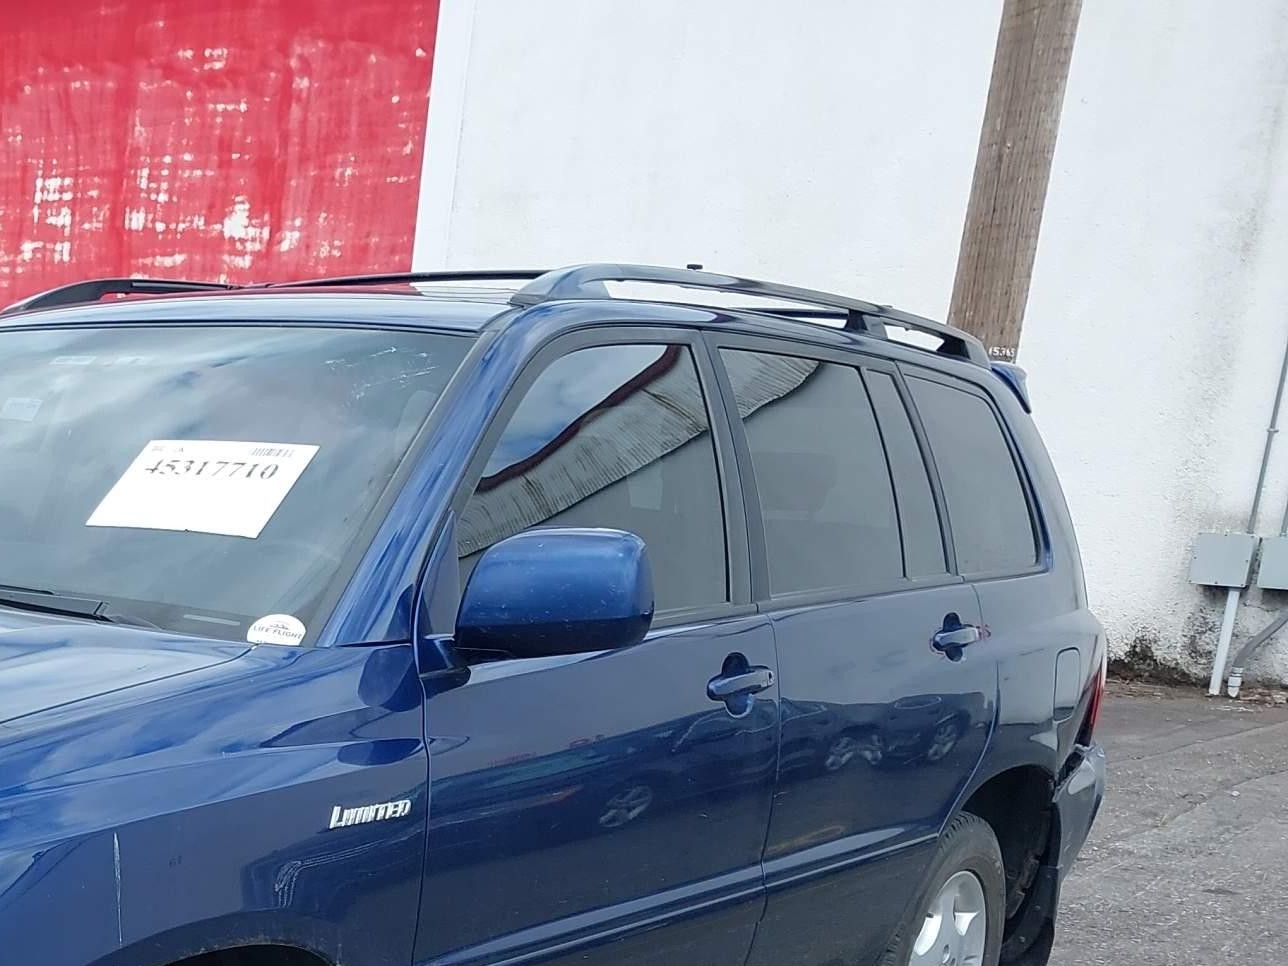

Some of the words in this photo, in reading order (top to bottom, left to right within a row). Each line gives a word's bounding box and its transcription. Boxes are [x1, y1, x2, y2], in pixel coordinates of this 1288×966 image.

[145, 458, 279, 480] 45317710
[272, 628, 303, 640] FLIGHT
[329, 800, 411, 829] LIMITED
